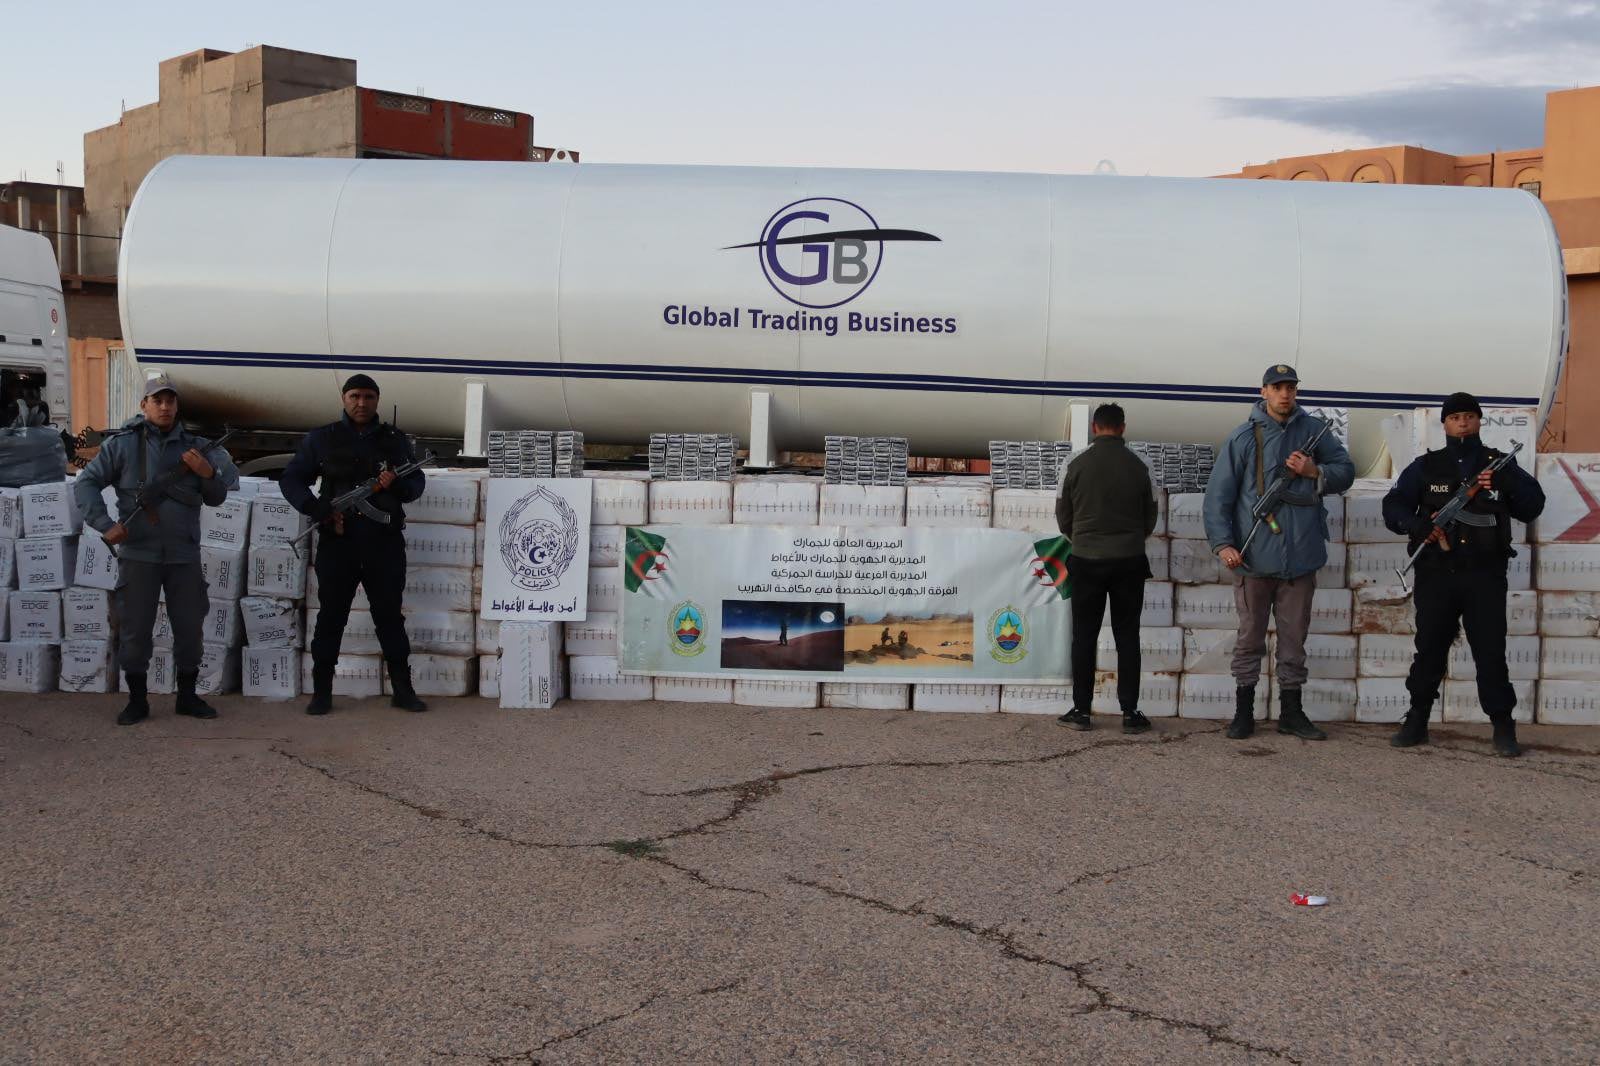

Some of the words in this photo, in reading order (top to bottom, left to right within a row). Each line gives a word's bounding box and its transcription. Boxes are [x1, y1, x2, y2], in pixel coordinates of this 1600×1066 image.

[663, 305, 740, 328] Global
[747, 308, 839, 336] Trading
[848, 311, 957, 334] Business
[31, 494, 59, 503] EDGE
[263, 505, 290, 514] EDGE
[208, 529, 235, 541] EDGE
[793, 538, 830, 549] للجمارك
[832, 538, 864, 548] العامة
[865, 539, 903, 550] المديرية
[87, 547, 95, 575] EDGE
[771, 551, 807, 563] بالأغواط
[810, 554, 846, 564] للجمارك
[849, 555, 886, 565] الجهوية
[888, 555, 926, 565] المديرية
[219, 561, 227, 589] EDGE
[518, 565, 554, 577] POLICE
[771, 569, 813, 579] الجمركية
[815, 570, 852, 580] للحراسة
[855, 570, 888, 581] الفرعية
[890, 571, 927, 581] المديرية
[738, 584, 772, 594] التهريب
[774, 584, 812, 594] مكافحة
[815, 586, 833, 595] في
[836, 585, 886, 596] المتخصصة
[888, 586, 926, 597] الجهوية
[928, 586, 958, 597] الفرقة
[21, 602, 49, 610] EDGE
[491, 596, 525, 613] الأغواط
[528, 599, 554, 613] ولاية
[557, 596, 577, 613] أمن
[215, 609, 224, 638] EDGE
[259, 629, 287, 639] EDGE
[155, 656, 163, 684] EDGE
